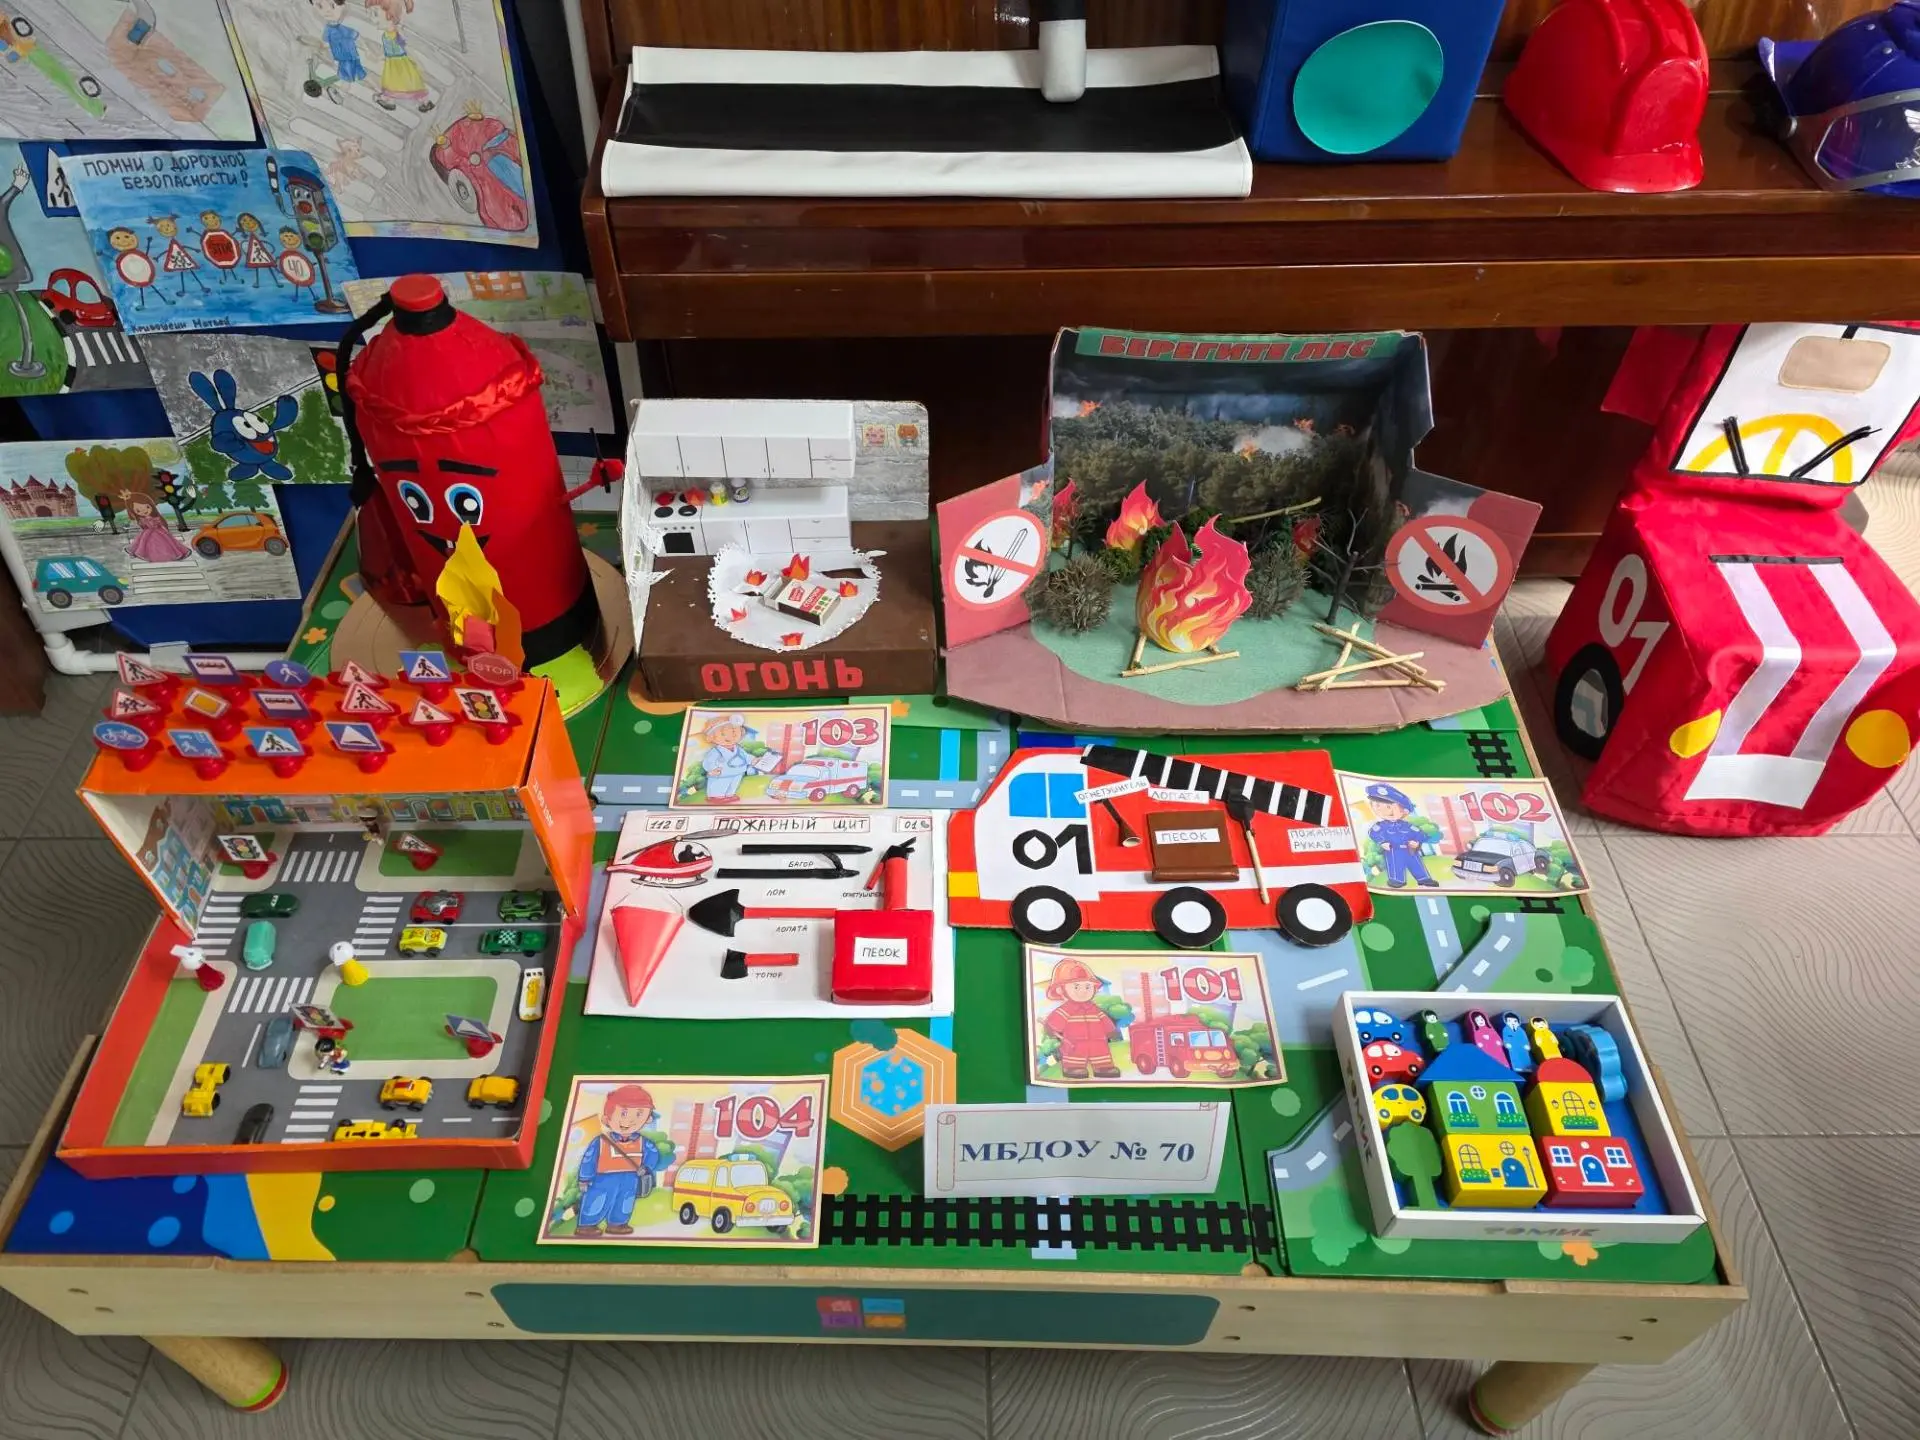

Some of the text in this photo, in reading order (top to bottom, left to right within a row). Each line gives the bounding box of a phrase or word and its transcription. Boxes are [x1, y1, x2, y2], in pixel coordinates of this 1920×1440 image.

[83, 152, 248, 177] ПОМНИ О ДОРОЖНОЙ
[1100, 335, 1377, 361] БЕРЕГИТЕ ЛЕС
[474, 661, 511, 677] STOP
[701, 658, 863, 692] ОГОНЬ
[801, 718, 880, 746] 103
[1077, 781, 1148, 801] ОГНЕТУШИТЕЛЬ
[1460, 791, 1552, 823] 102
[650, 820, 671, 831] 112
[717, 816, 867, 832] ПОЖАРНЫЙ ЩИТ
[1161, 831, 1208, 842] ПЕСОК
[1012, 824, 1093, 875] 01
[788, 860, 814, 868] БАГОР
[766, 888, 786, 897] ЛОМ
[775, 924, 808, 933] ЛОПАТА
[862, 947, 901, 958] ПЕСОК
[755, 971, 783, 979] ТОПОР
[1160, 966, 1243, 1001] 101
[714, 1095, 814, 1138] 104
[959, 1139, 1195, 1164] МБДОУ № 70
